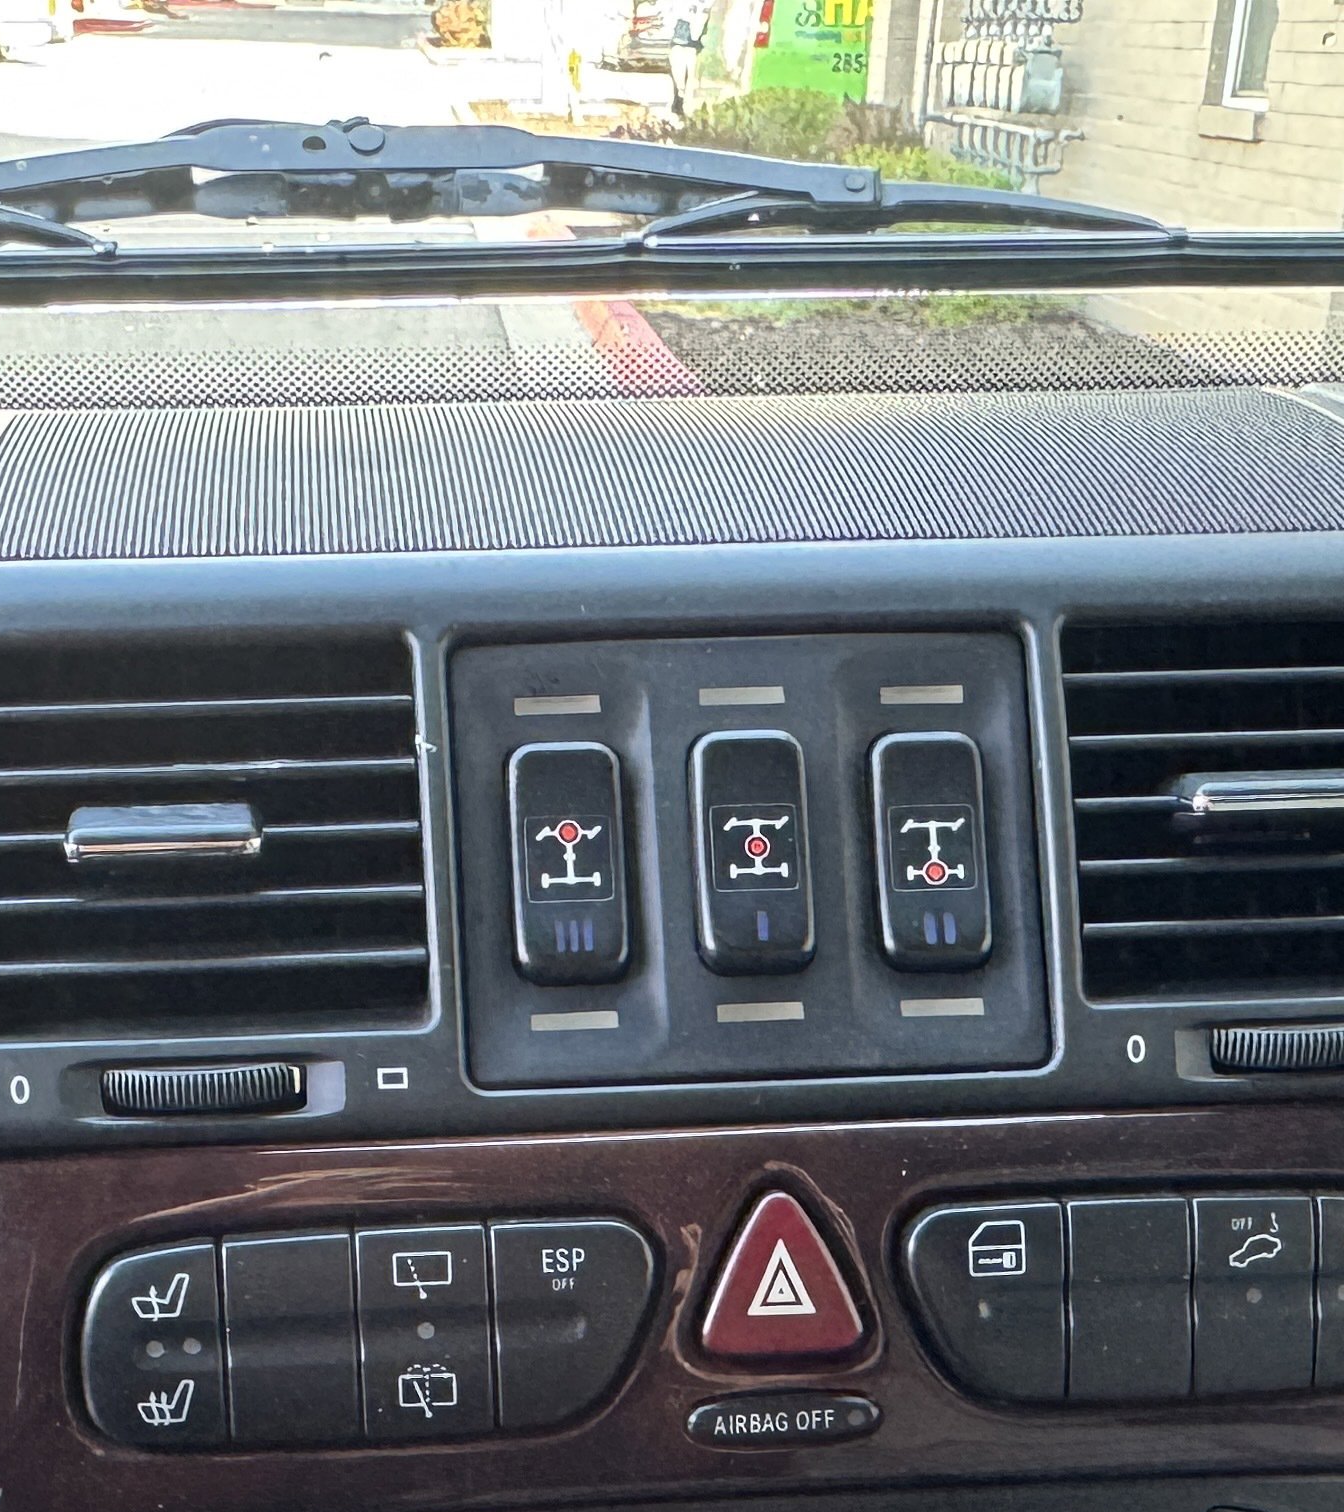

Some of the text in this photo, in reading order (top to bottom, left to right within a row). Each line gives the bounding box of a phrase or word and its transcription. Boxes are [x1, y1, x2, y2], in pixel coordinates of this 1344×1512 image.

[541, 1247, 586, 1274] ESP
[551, 1276, 576, 1292] OFF
[714, 1409, 836, 1436] AIRBAG OFF
